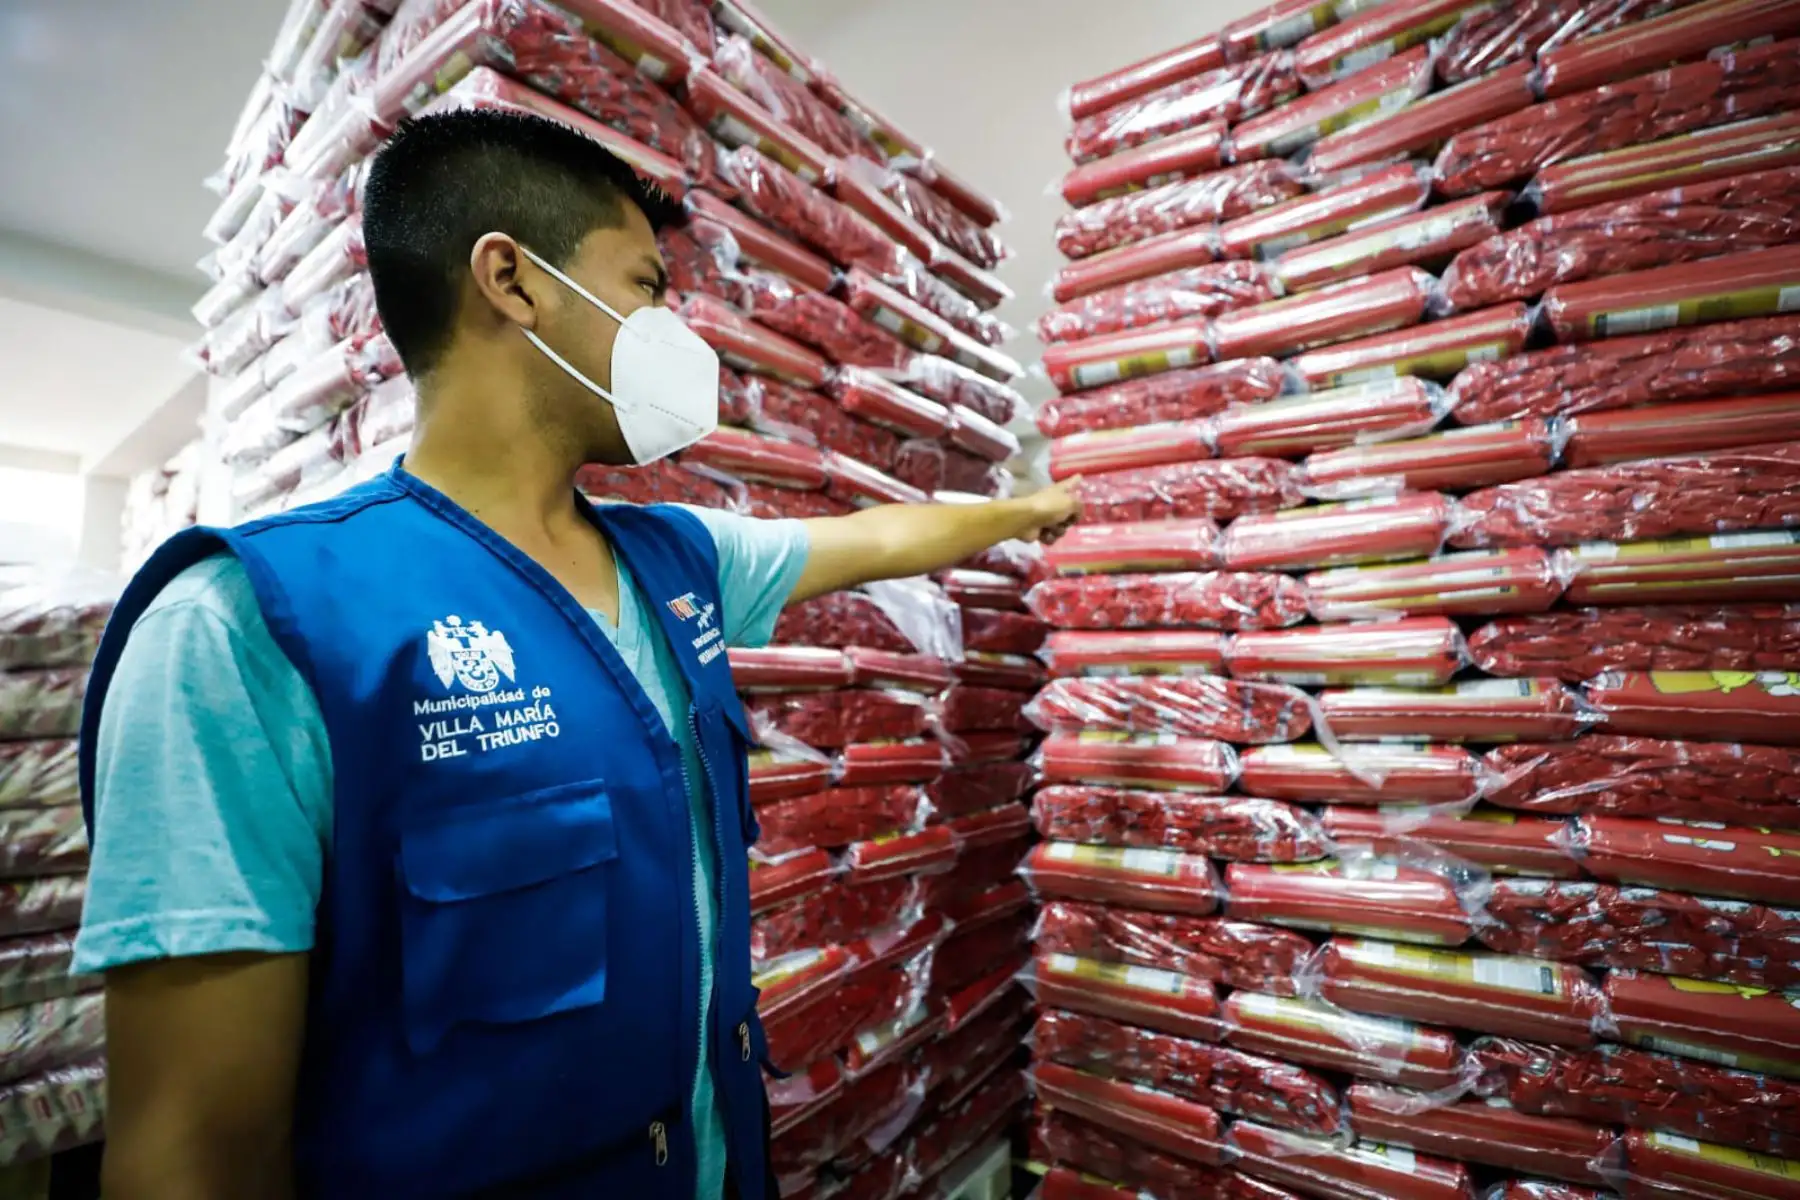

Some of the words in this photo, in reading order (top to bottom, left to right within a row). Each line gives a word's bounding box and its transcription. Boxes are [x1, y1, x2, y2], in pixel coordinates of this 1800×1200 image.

[413, 688, 525, 715] Municipalidad
[531, 685, 551, 699] de
[418, 714, 485, 742] VILLA
[495, 700, 556, 728] MARÍA
[420, 738, 467, 762] DEL
[475, 721, 560, 752] TRIUNFO
